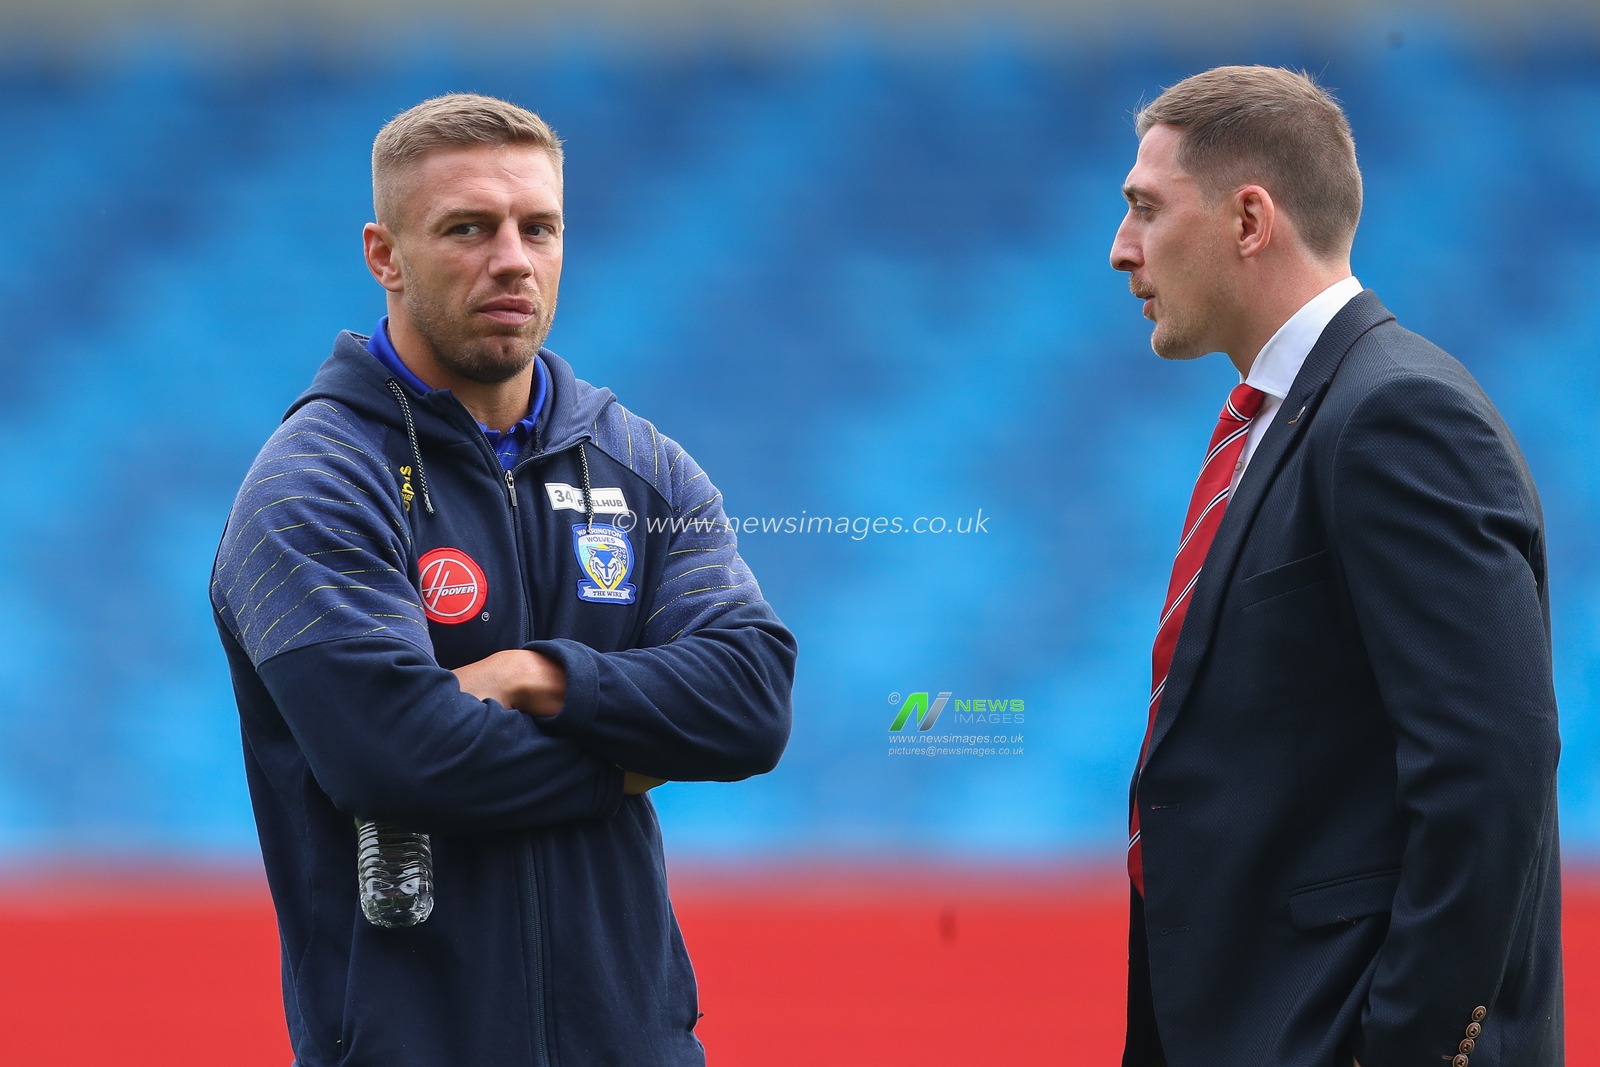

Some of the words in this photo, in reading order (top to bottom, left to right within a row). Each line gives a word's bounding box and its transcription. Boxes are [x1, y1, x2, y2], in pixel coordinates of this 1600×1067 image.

[577, 499, 624, 508] FELHUB
[576, 527, 623, 539] WARINGTON
[586, 536, 616, 544] WOLVES
